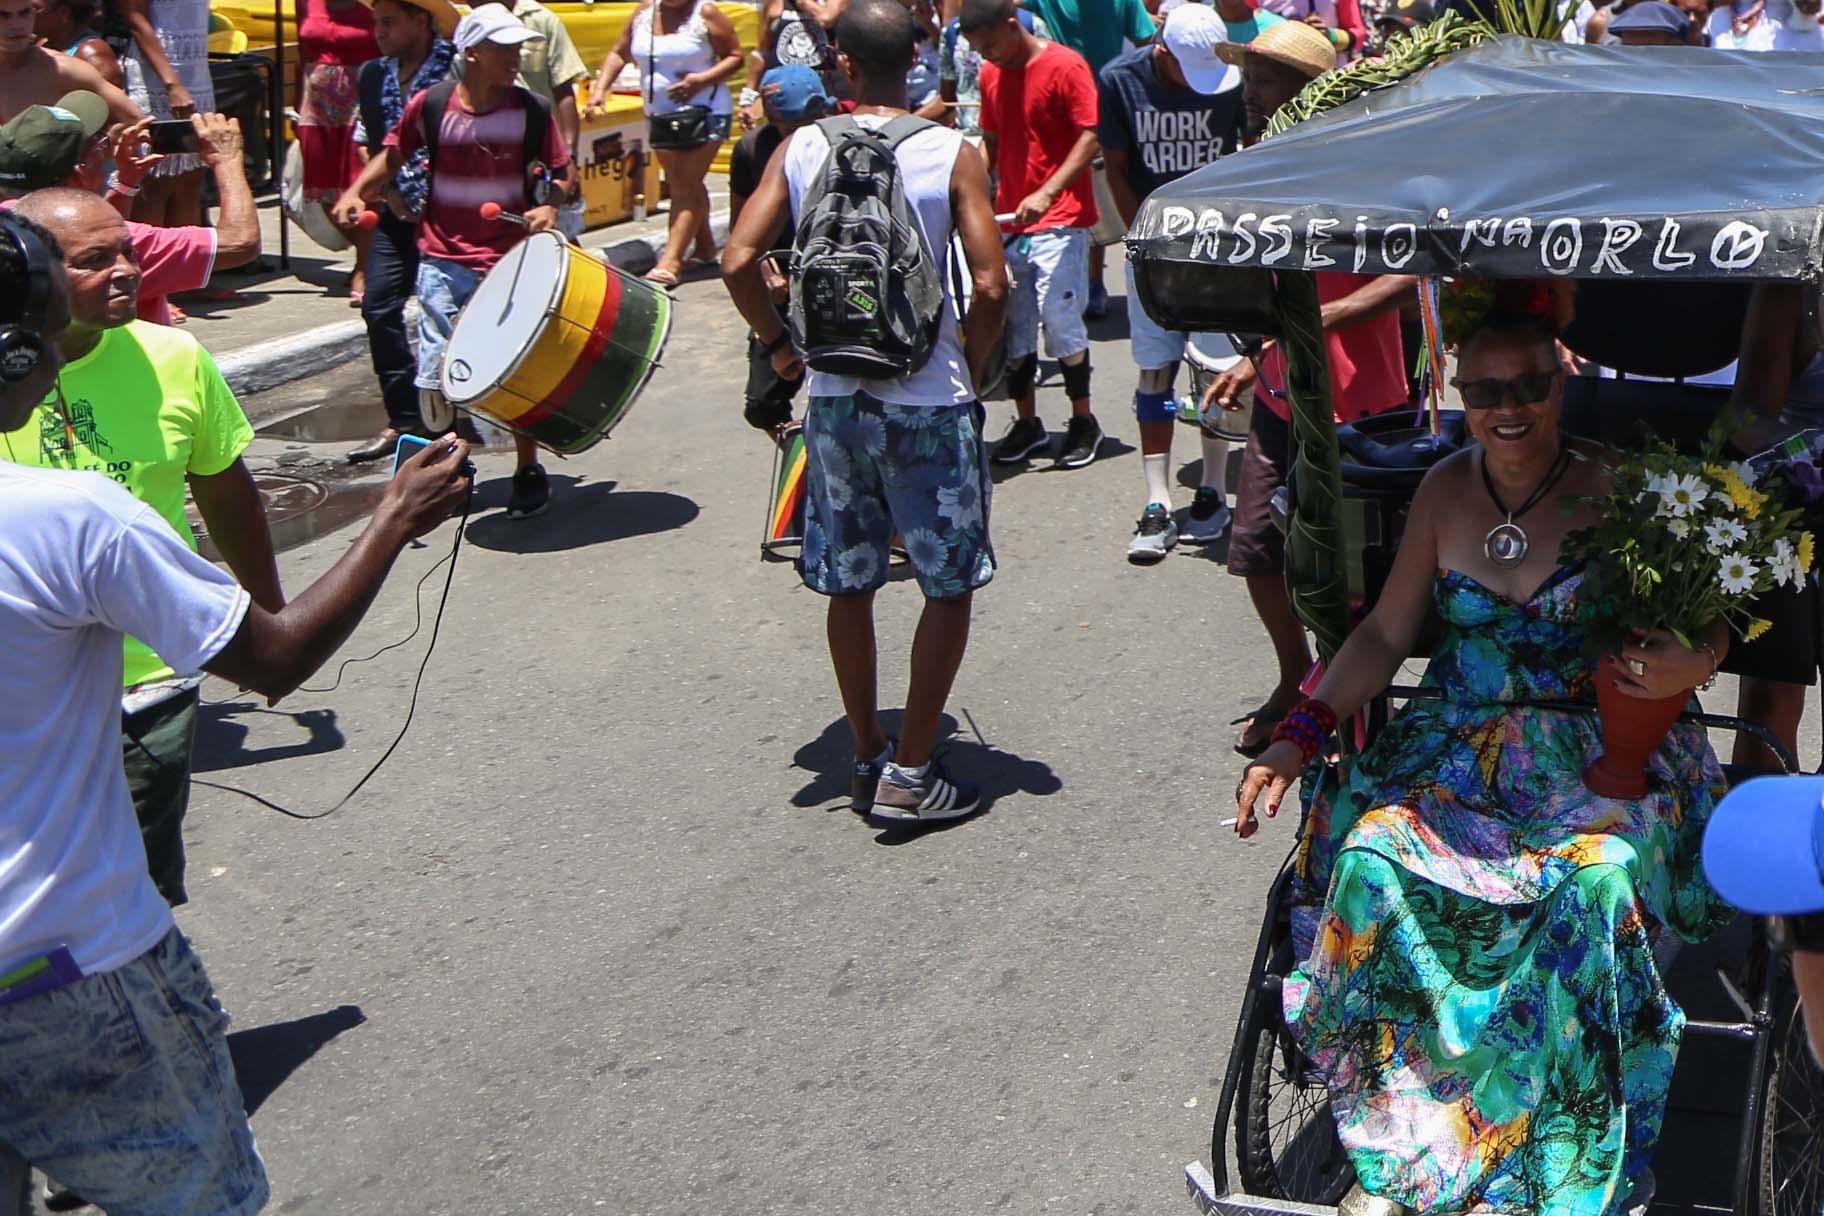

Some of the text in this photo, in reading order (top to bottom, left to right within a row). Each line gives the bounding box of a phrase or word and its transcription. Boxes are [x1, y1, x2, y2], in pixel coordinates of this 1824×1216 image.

[1135, 109, 1213, 142] WORK
[1141, 137, 1223, 174] ARDER
[106, 460, 131, 473] DO
